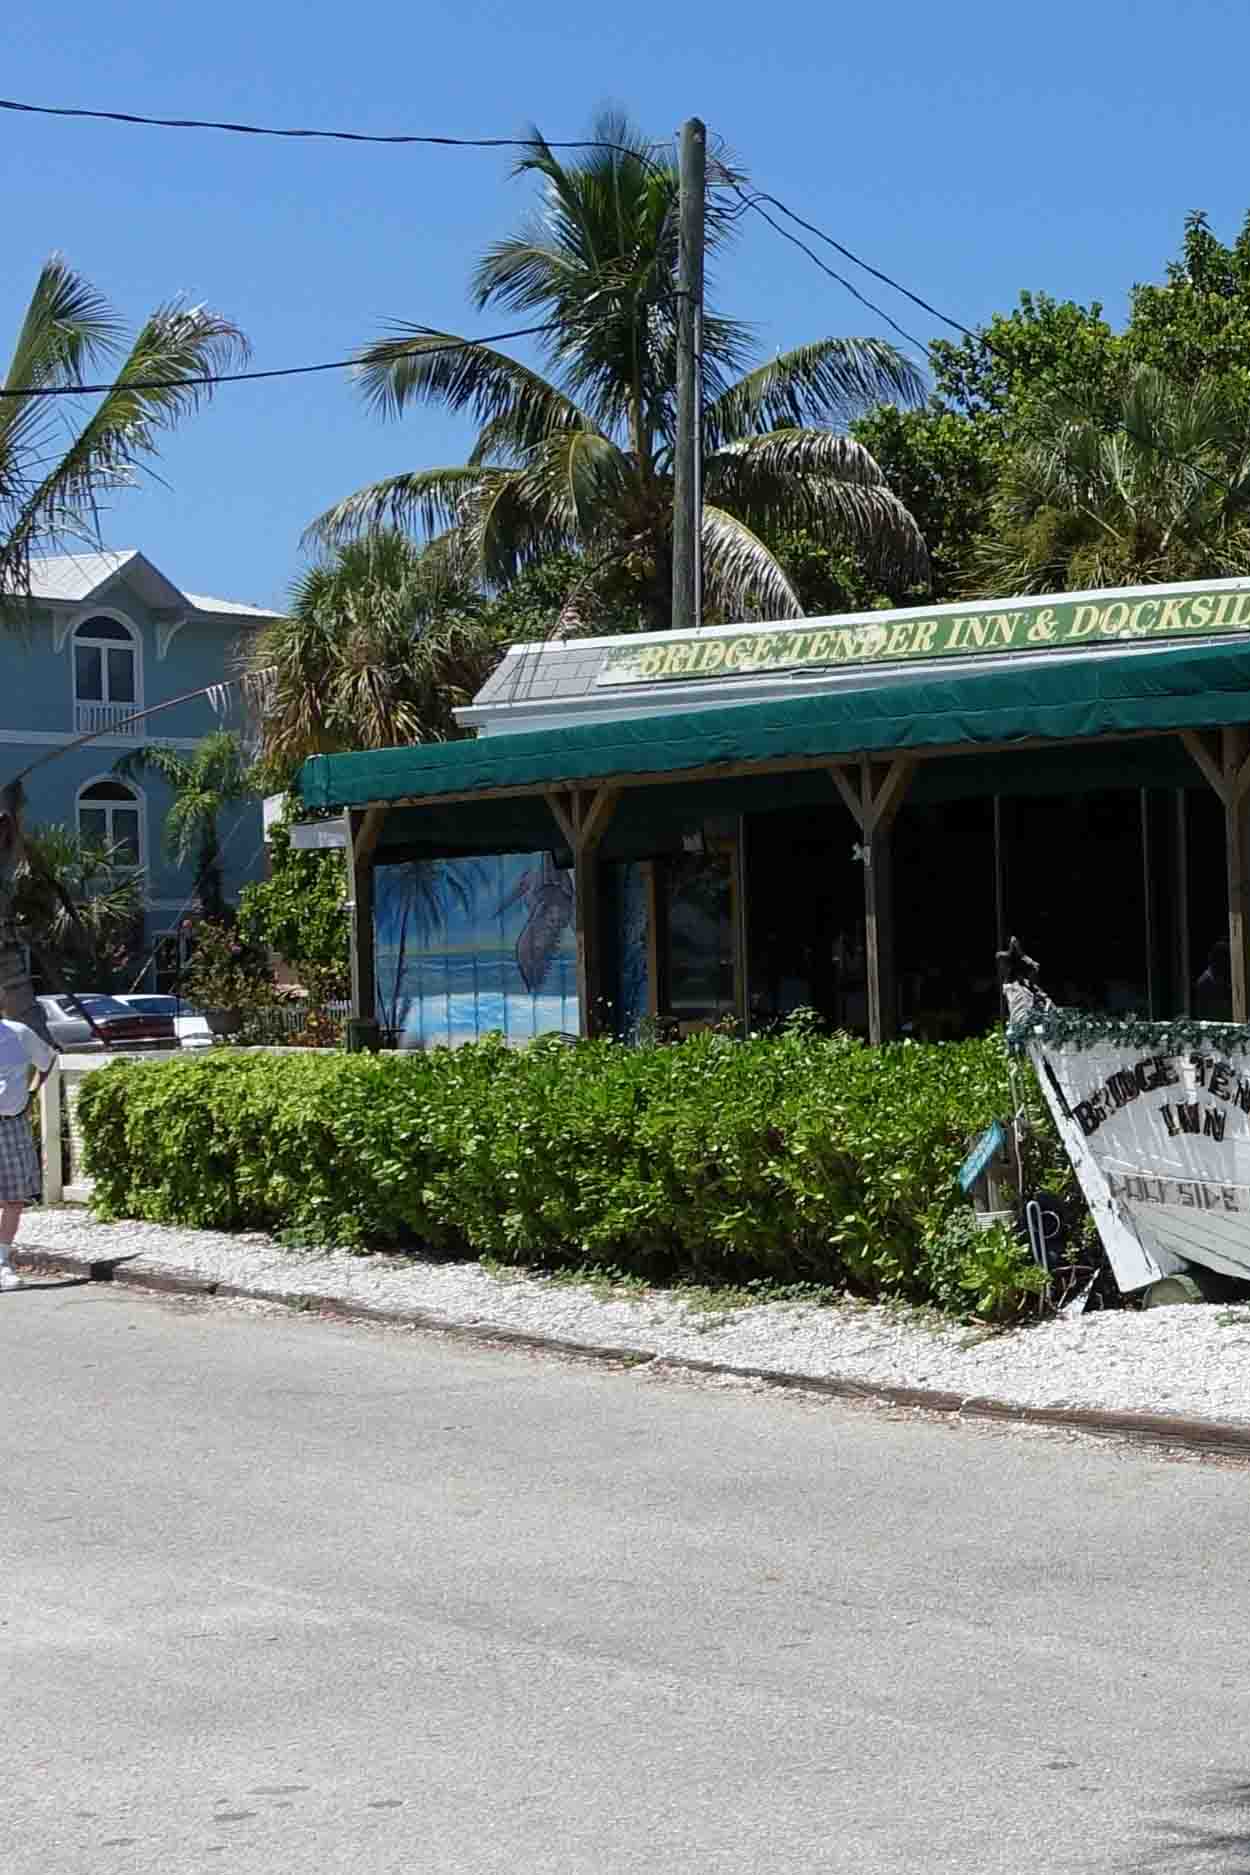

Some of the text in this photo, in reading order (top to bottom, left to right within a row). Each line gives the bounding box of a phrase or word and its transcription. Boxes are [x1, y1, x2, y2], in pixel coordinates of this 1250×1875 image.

[638, 633, 774, 676] BRIDGE
[782, 619, 938, 668] TENDER
[944, 611, 1020, 650] INN
[1026, 607, 1058, 641] &
[1071, 1055, 1180, 1136] BRIDGE
[1159, 1102, 1228, 1142] INN
